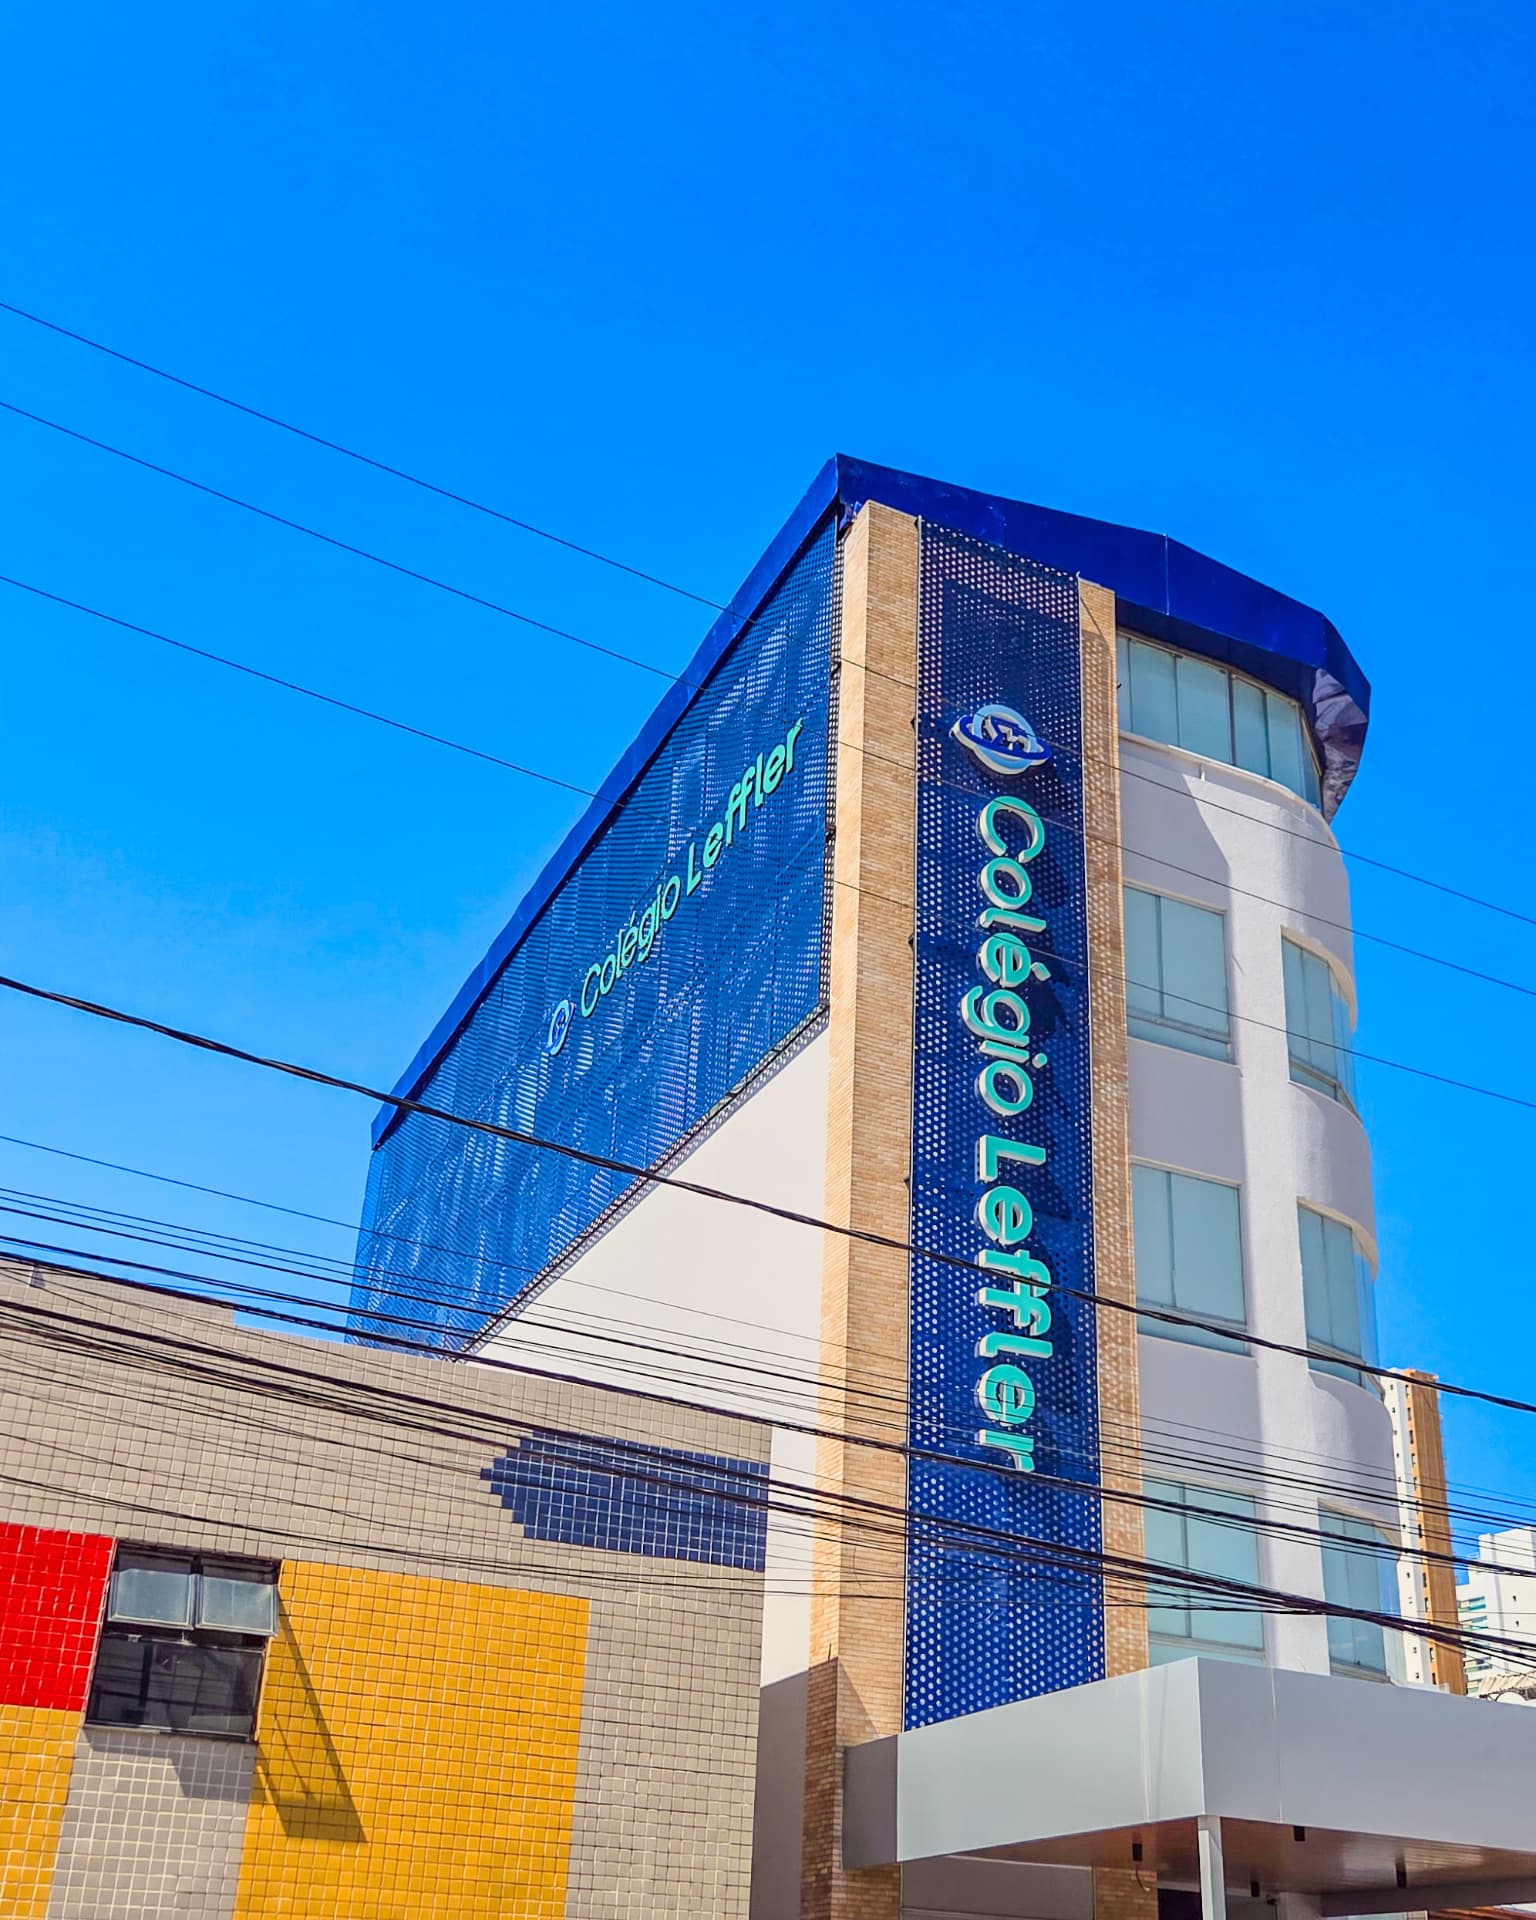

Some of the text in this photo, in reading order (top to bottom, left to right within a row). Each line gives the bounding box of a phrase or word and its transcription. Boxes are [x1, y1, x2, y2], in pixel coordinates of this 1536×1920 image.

[580, 718, 802, 1018] Colégio Leffler
[960, 797, 1052, 1117] Colégio
[978, 1134, 1053, 1474] Leffler
